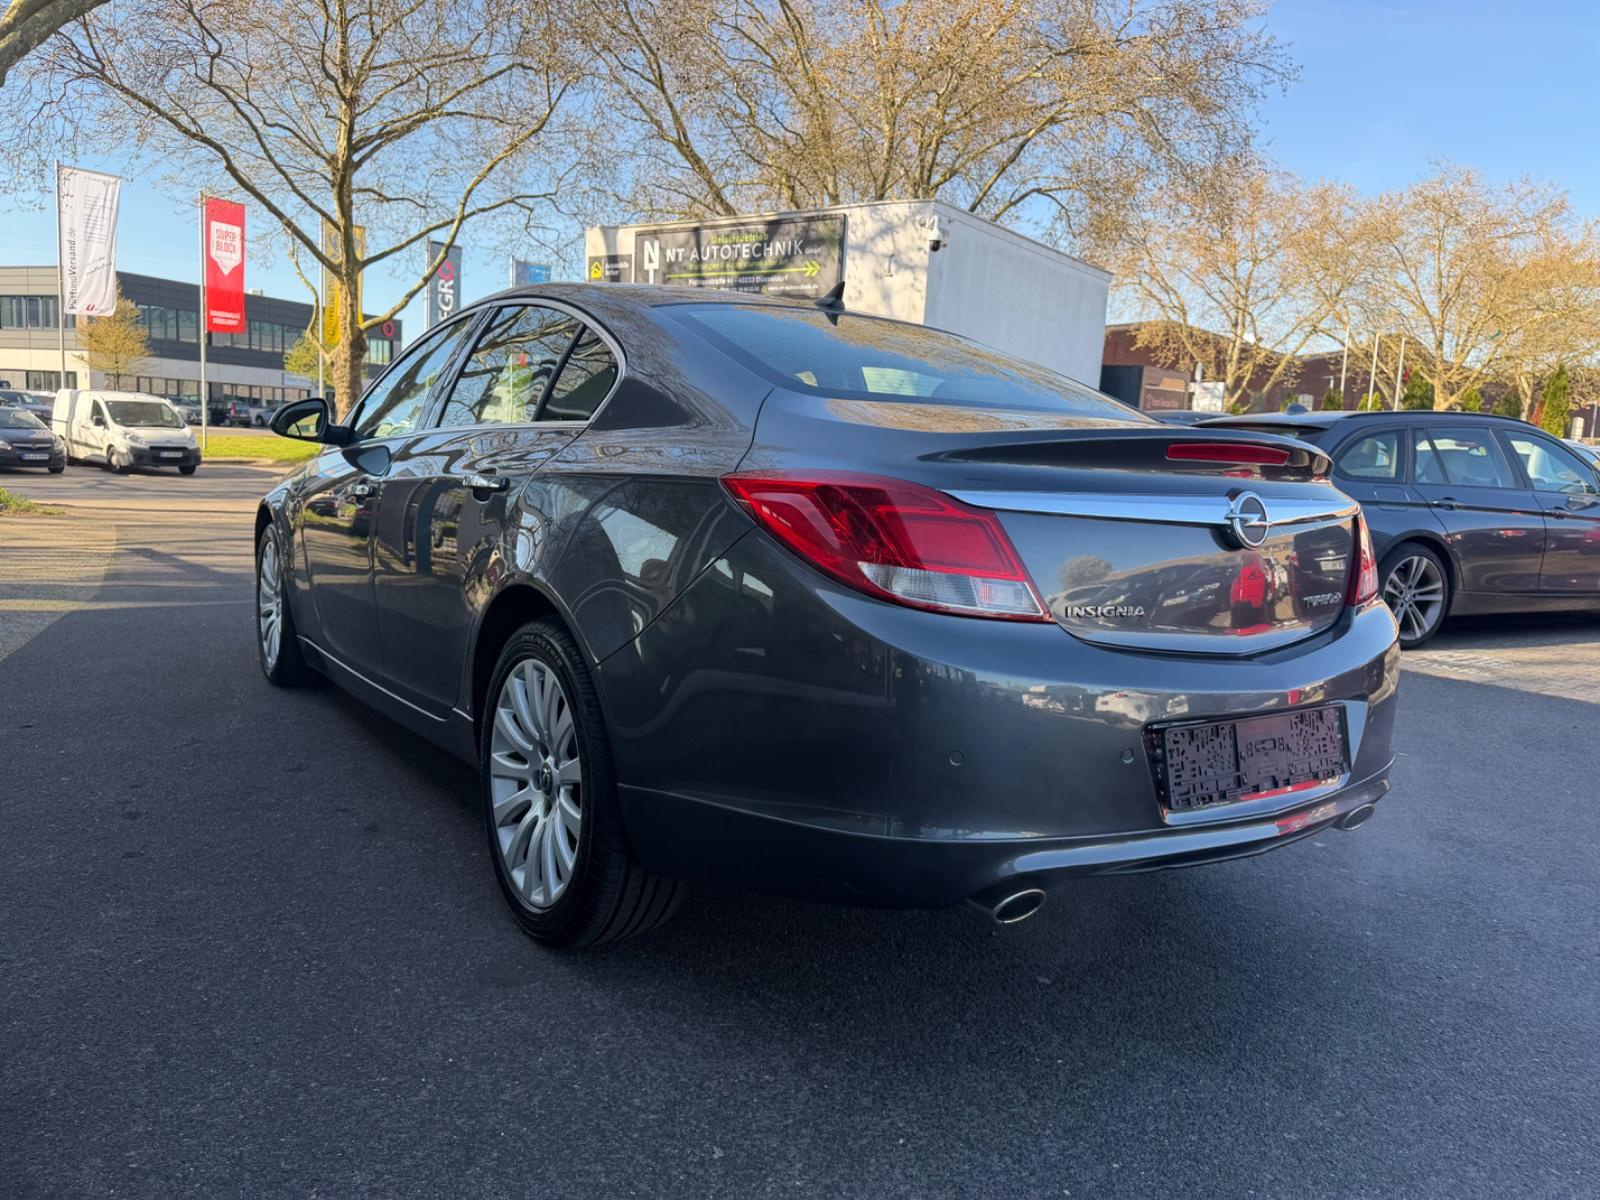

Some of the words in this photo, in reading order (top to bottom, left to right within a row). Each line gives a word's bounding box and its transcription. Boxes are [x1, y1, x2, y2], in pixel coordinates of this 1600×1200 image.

[215, 228, 237, 242] SUPER
[215, 240, 237, 254] BLOCK
[665, 248, 685, 262] NT
[689, 240, 804, 262] AUTOTECHNIK
[1064, 605, 1145, 618] INSIGNIA
